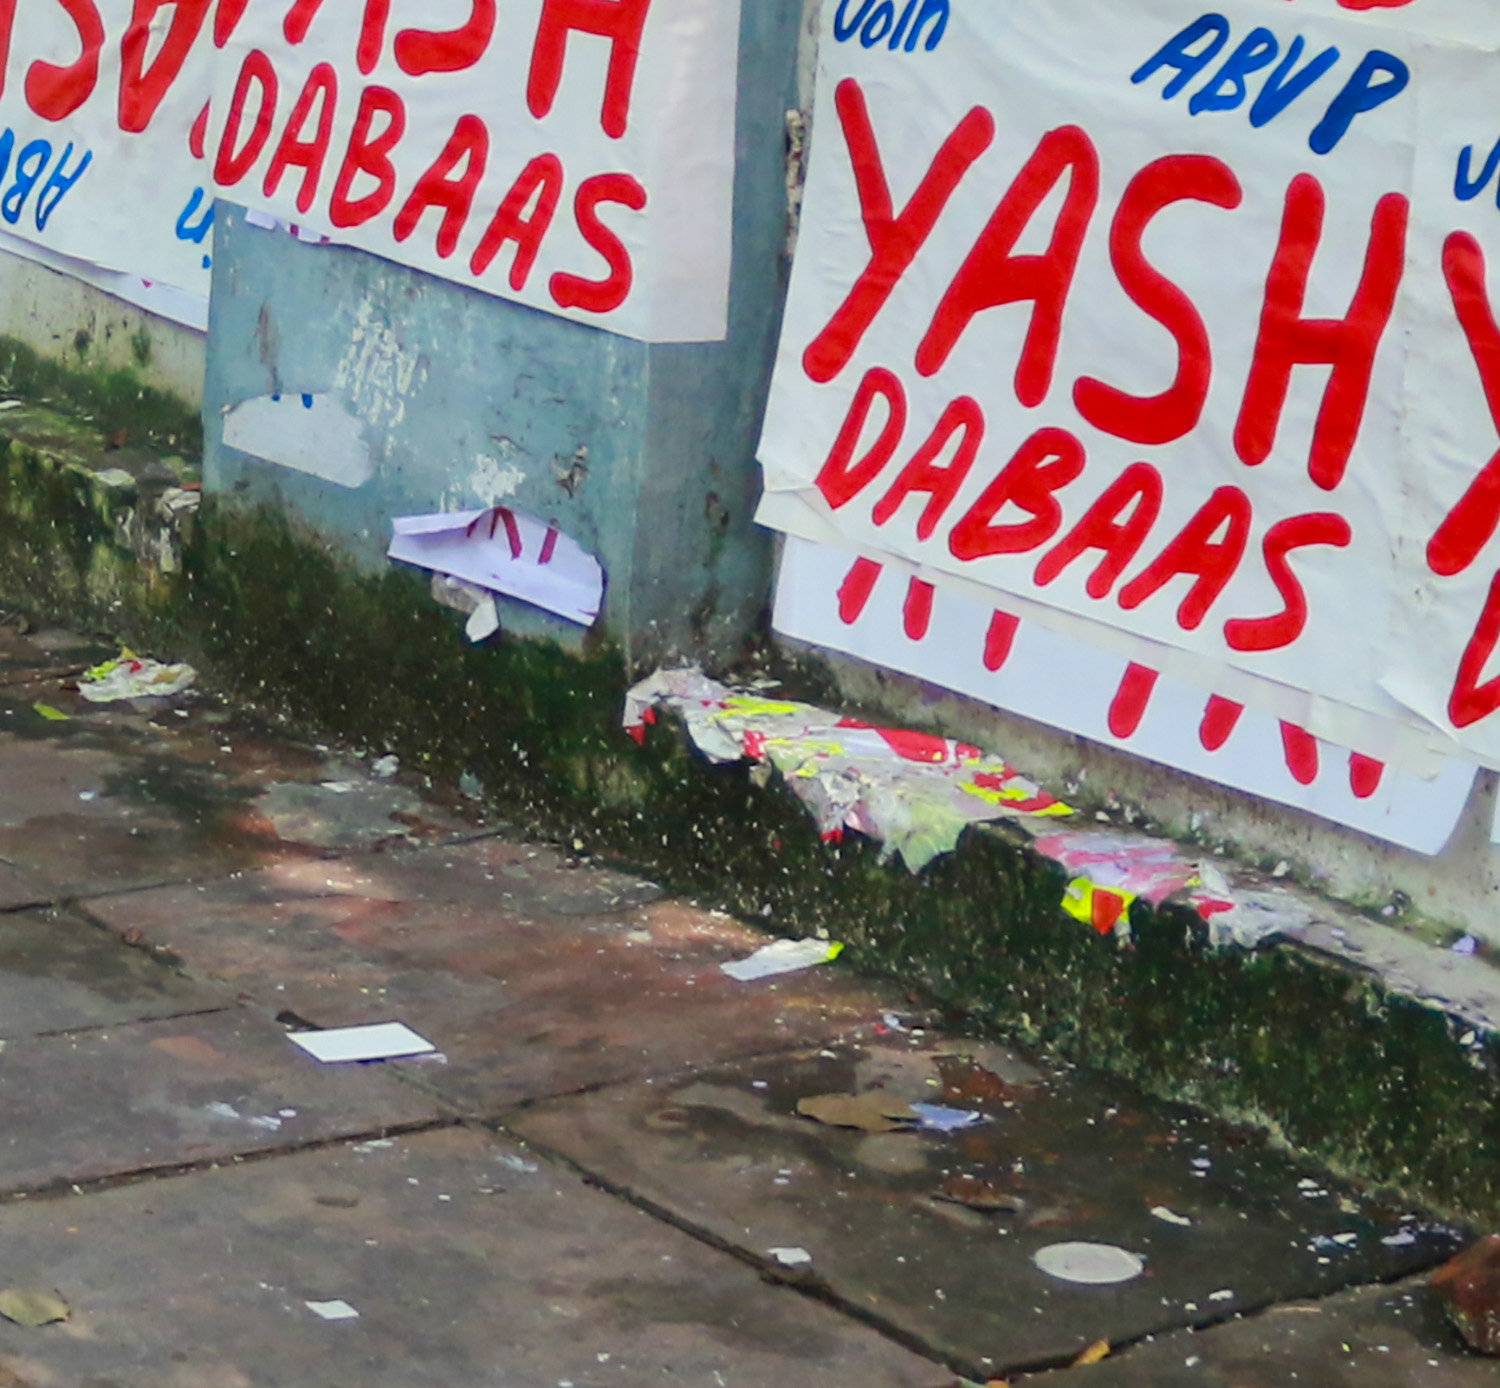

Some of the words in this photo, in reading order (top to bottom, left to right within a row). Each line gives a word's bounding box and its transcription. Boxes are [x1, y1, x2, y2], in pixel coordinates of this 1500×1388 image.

[214, 50, 648, 314] DABAAS
[1129, 11, 1410, 155] ABVP
[801, 77, 1410, 491] YASH
[815, 366, 1352, 653] DABAAS
